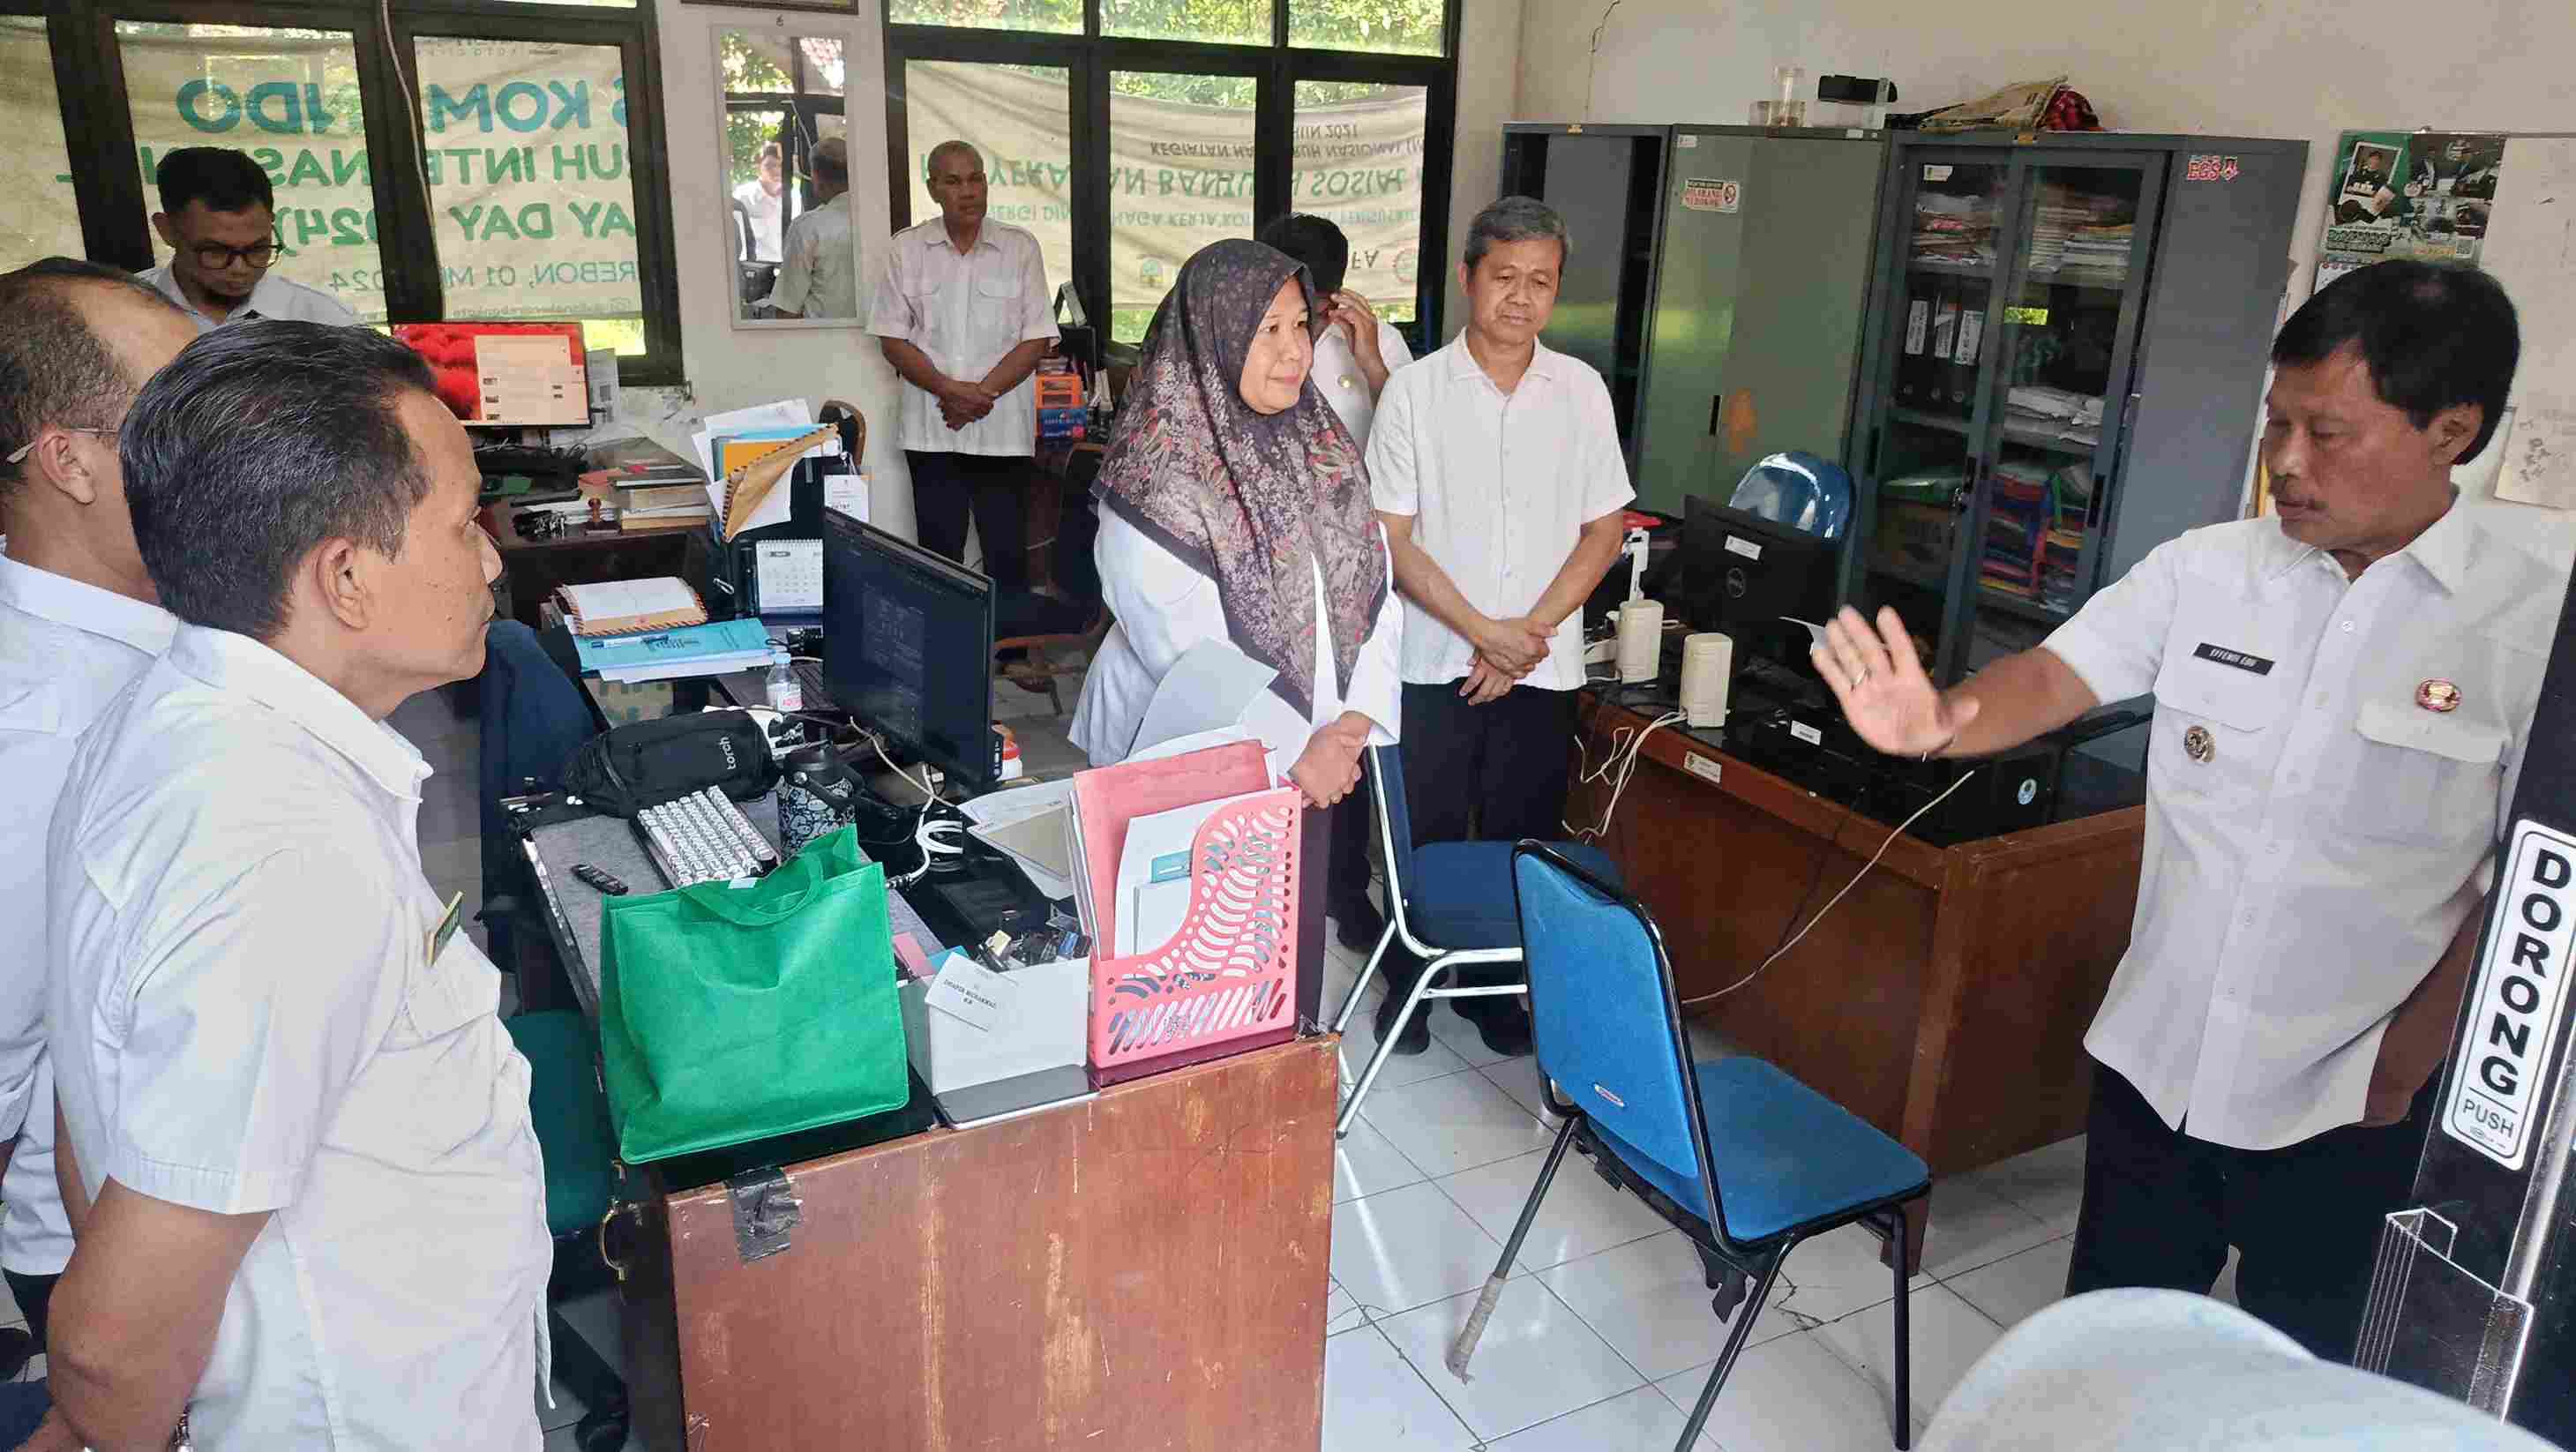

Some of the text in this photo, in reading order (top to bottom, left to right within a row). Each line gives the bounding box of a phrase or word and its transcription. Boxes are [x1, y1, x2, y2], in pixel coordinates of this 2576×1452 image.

[719, 736, 738, 770] torch
[2479, 848, 2572, 1096] DORONG
[2462, 1097, 2515, 1139] PUSH
